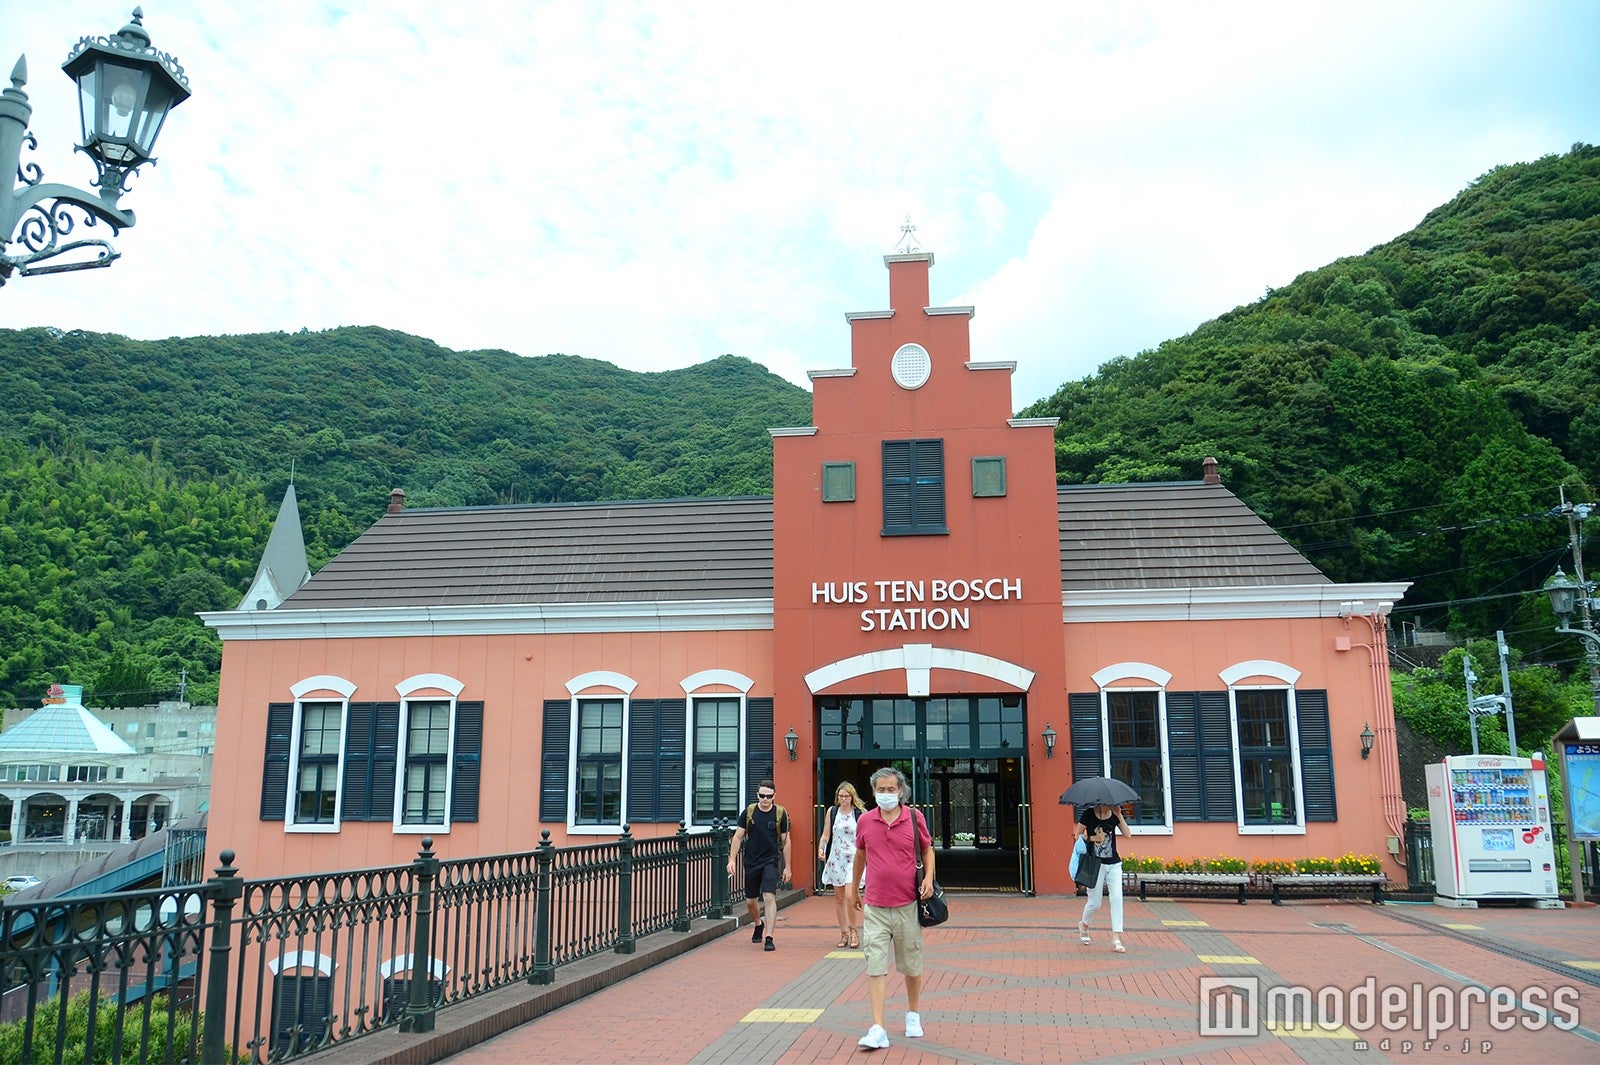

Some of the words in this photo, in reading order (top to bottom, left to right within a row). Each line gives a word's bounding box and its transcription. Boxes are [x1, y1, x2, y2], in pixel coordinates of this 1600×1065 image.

[811, 581, 869, 603] HUIS
[874, 580, 925, 602] TEN
[931, 578, 1022, 602] BOSCH
[860, 607, 970, 631] STATION
